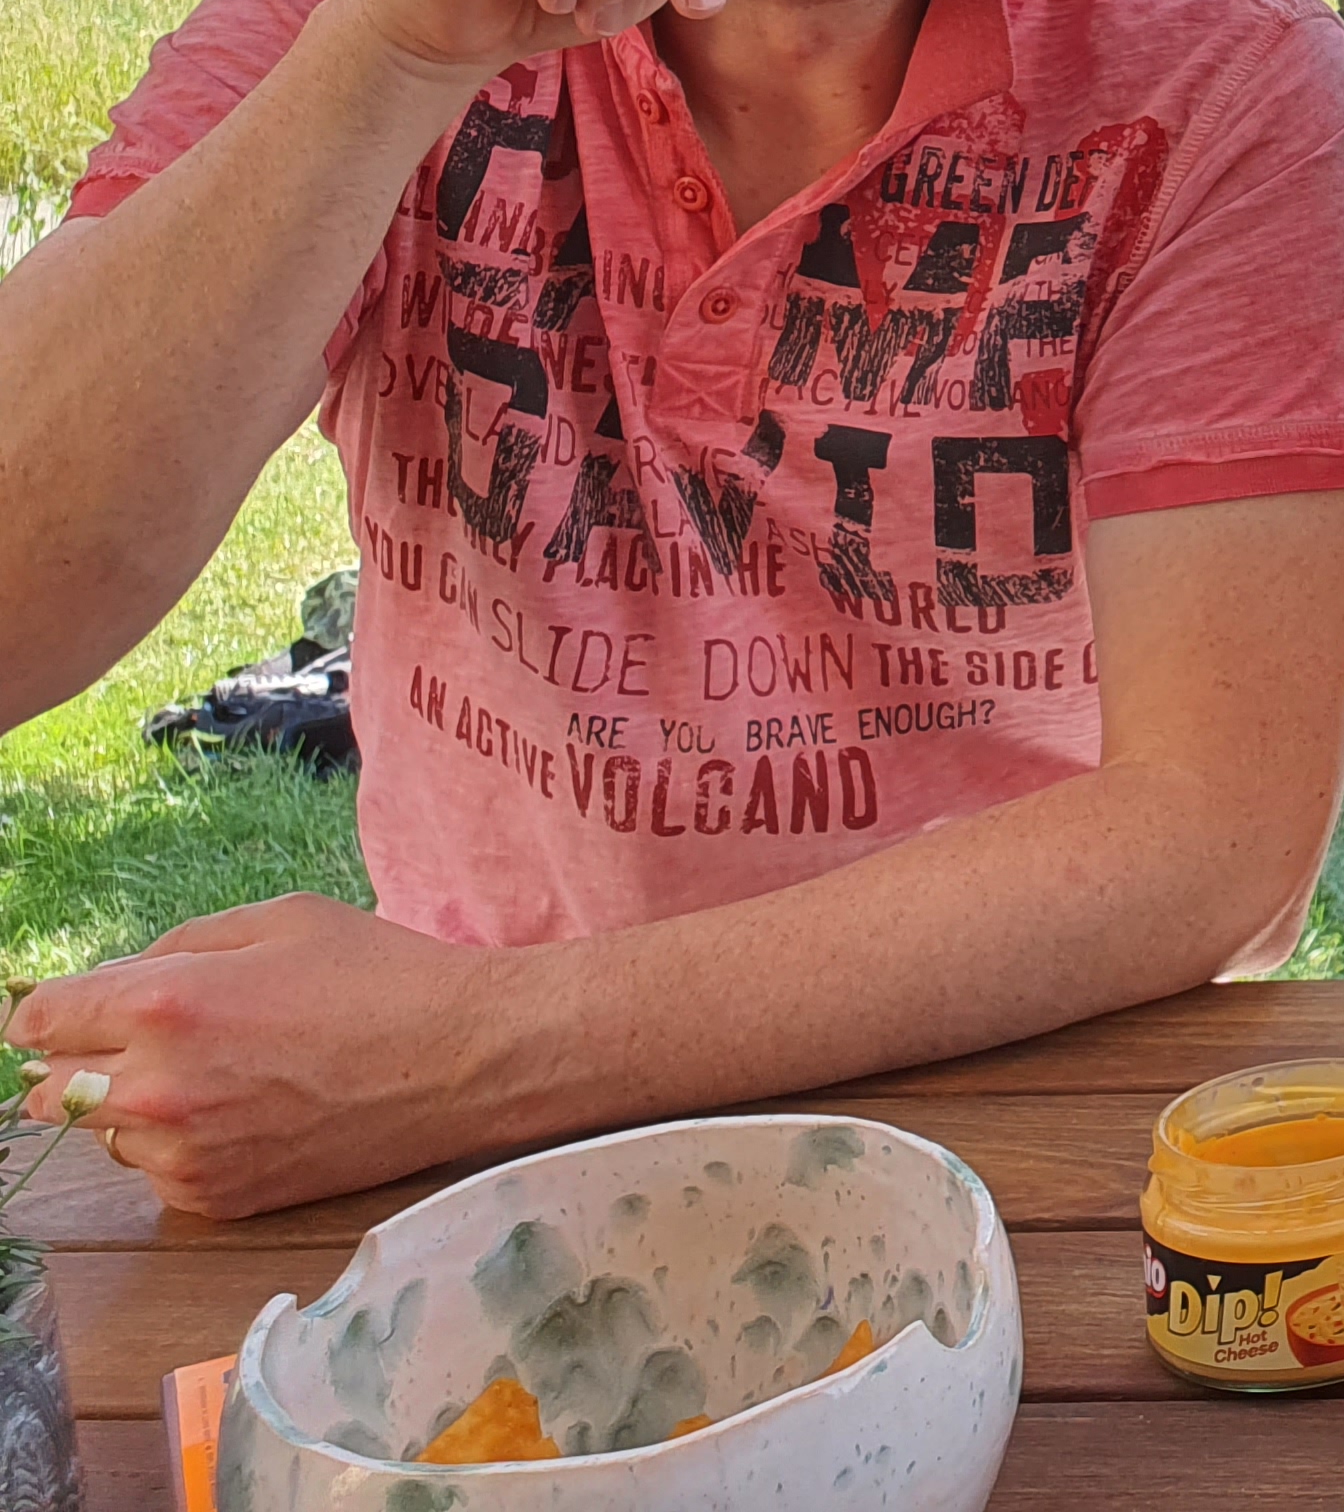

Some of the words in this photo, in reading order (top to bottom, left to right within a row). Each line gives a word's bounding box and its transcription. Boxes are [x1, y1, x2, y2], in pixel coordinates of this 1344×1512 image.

[879, 144, 1030, 216] GREEN
[364, 515, 423, 592] YOU
[491, 597, 656, 697] SLIDE
[703, 631, 855, 702] DOWN
[871, 641, 950, 688] THE
[966, 647, 1065, 691] SIDE
[409, 664, 448, 732] AN
[454, 694, 556, 800] ACTIVE
[566, 712, 631, 751] ARE
[659, 718, 717, 755] YOU
[745, 711, 838, 753] BRAVE
[857, 698, 997, 741] ENOUGH?
[1168, 1269, 1284, 1346] Dip!
[1238, 1330, 1268, 1347] Hot
[1213, 1341, 1280, 1364] Cheese
